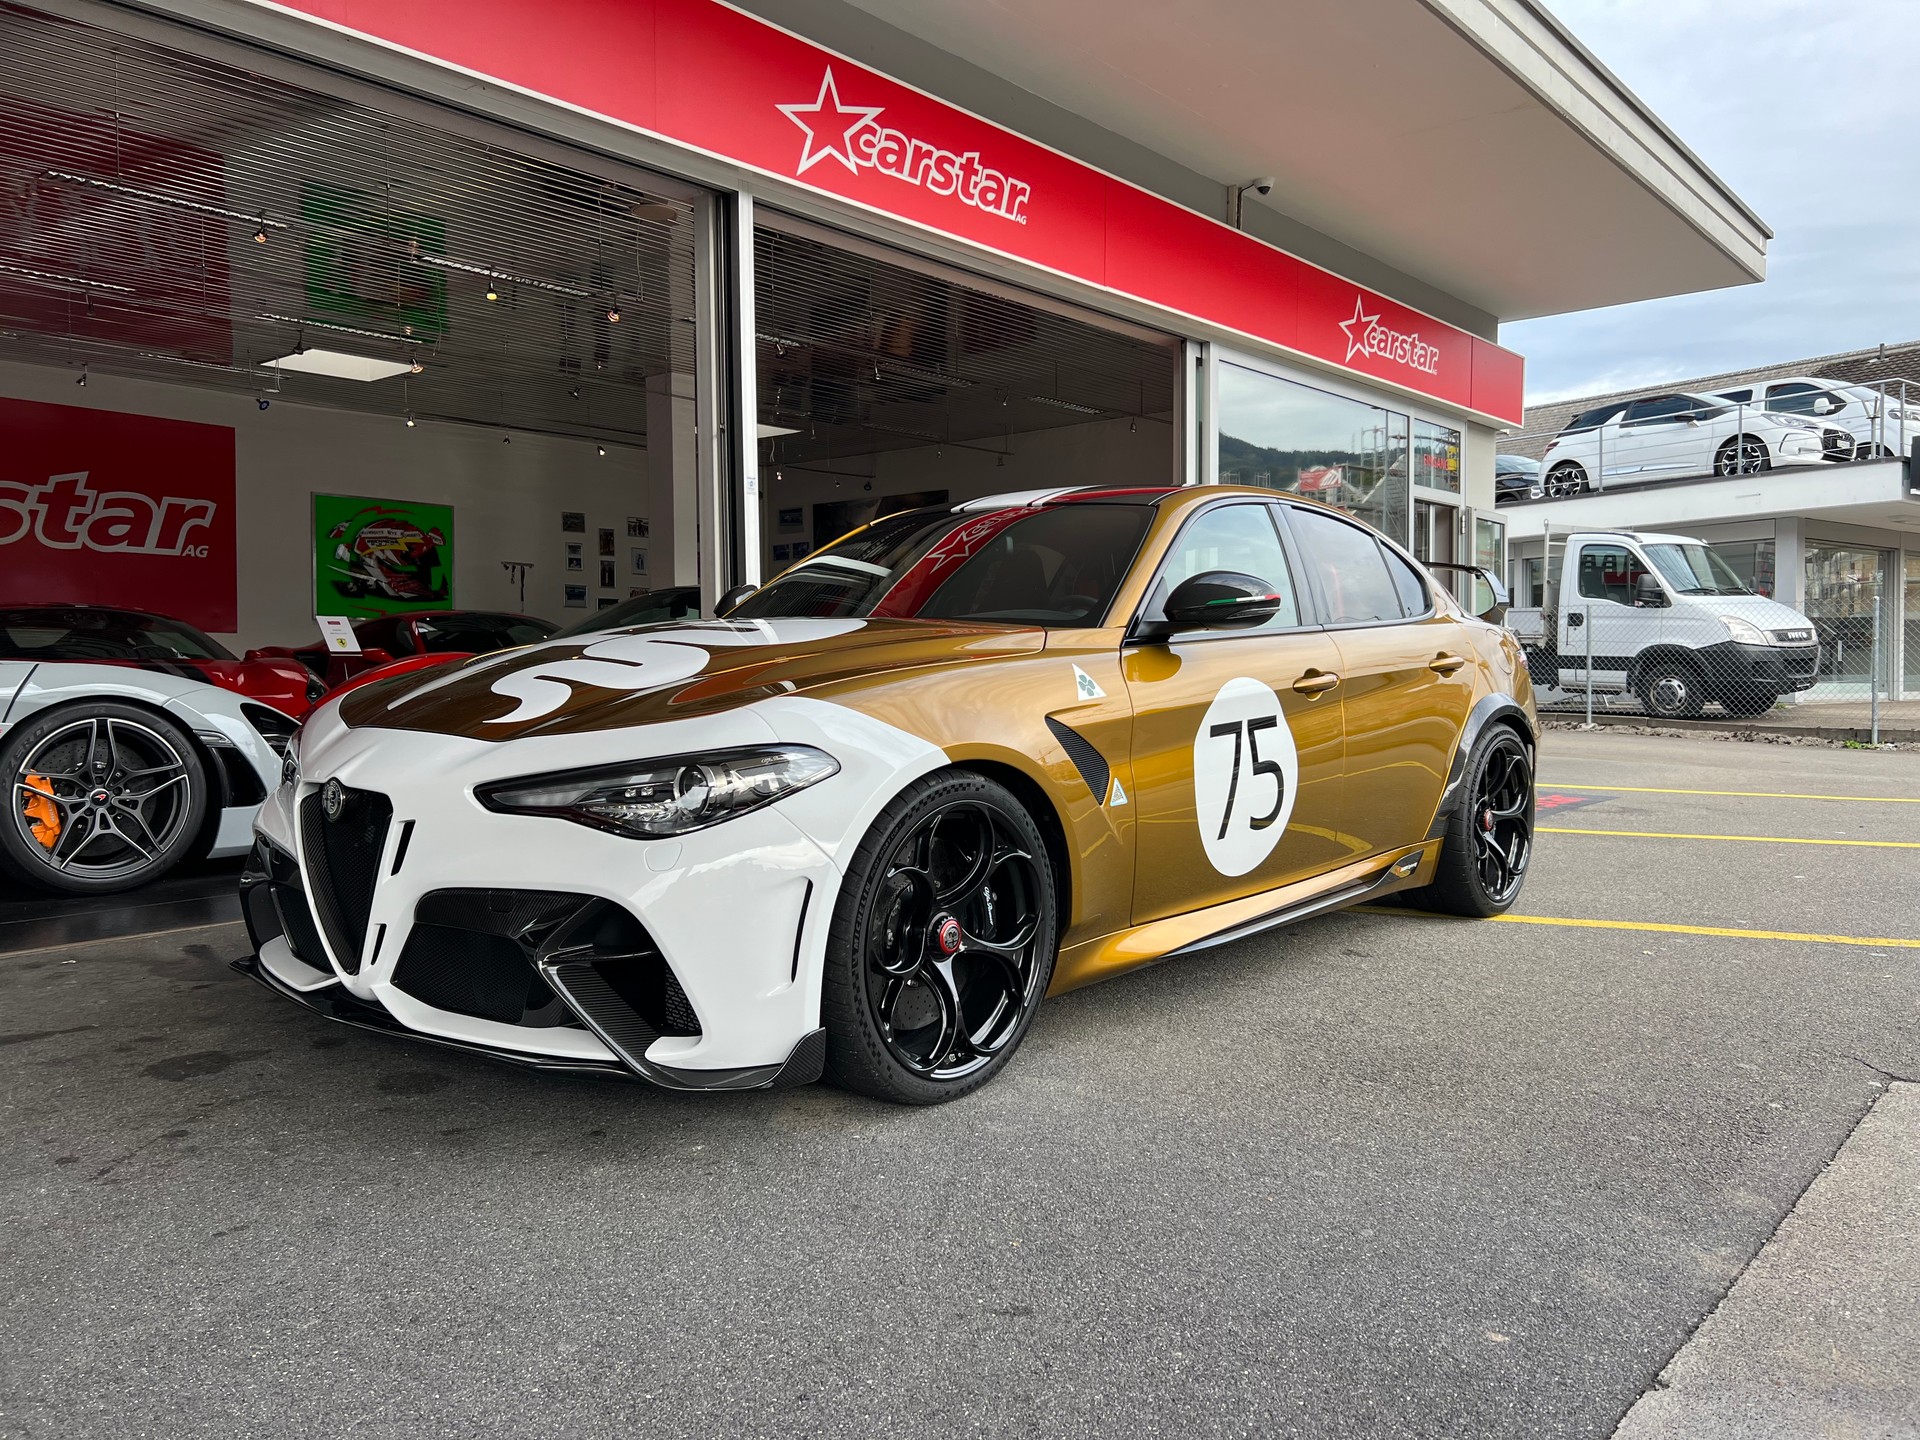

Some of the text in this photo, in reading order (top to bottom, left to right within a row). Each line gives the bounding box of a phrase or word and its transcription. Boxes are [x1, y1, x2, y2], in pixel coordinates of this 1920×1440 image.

[849, 122, 1031, 225] carstar AG
[1365, 323, 1440, 374] carstar
[182, 545, 209, 558] AG
[1787, 631, 1808, 639] IVECO
[1209, 715, 1285, 840] 75
[853, 880, 870, 949] MICHELIN
